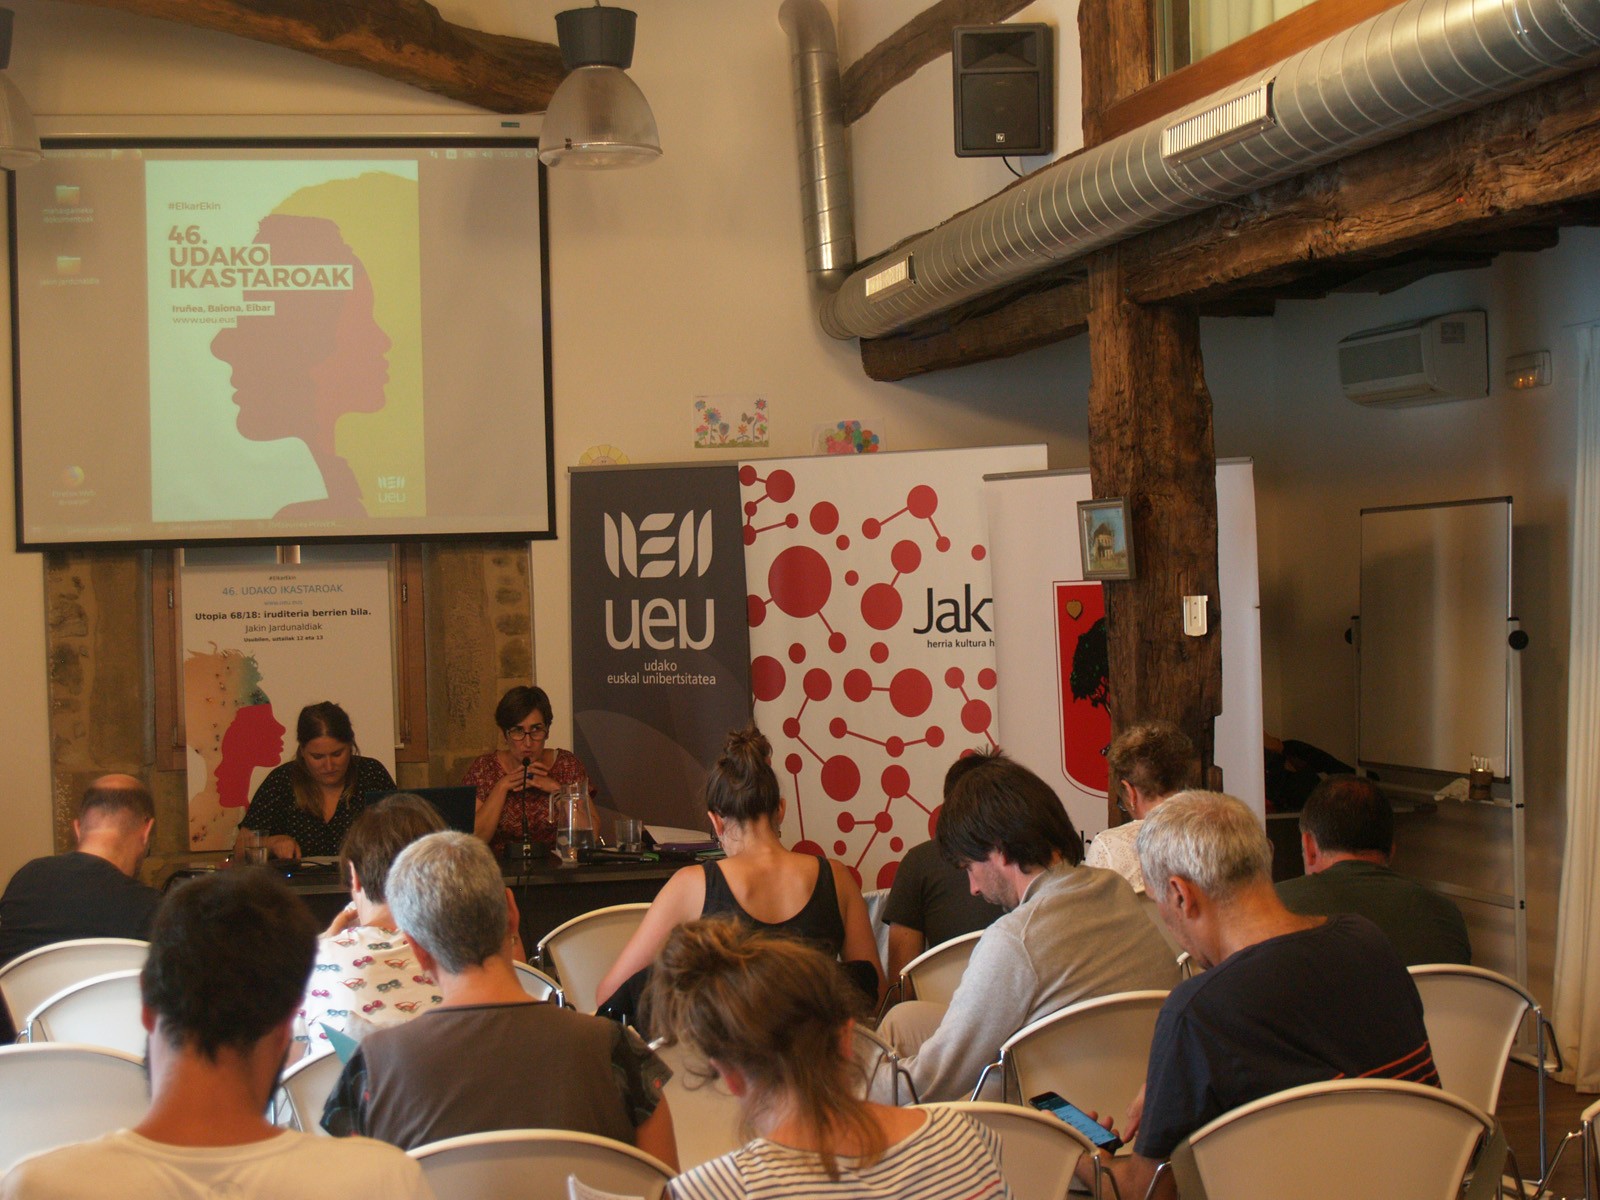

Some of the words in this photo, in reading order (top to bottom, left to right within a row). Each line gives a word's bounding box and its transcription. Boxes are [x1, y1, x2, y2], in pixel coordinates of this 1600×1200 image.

[168, 201, 221, 211] #ElkarEkin
[168, 225, 208, 245] 46.
[170, 246, 270, 267] UDAKO
[171, 267, 351, 288] IKASTAROAK
[172, 304, 206, 313] Iruñea,
[208, 304, 244, 313] Baiona,
[246, 303, 272, 312] Eibar
[173, 316, 236, 324] www.ueu.eus
[222, 586, 238, 596] 46.
[241, 585, 278, 596] UDAKO
[280, 584, 344, 594] IKASTAROAK
[195, 612, 227, 621] Utopia
[230, 611, 261, 620] 68/18:
[264, 609, 309, 618] iruditeria
[312, 608, 348, 617] berrien
[350, 607, 372, 616] bila.
[245, 624, 266, 634] Jakin
[268, 622, 323, 633] Jardunaldiak
[927, 639, 953, 648] herria
[955, 639, 987, 648] kultura
[644, 659, 678, 671] udako
[607, 672, 640, 684] euskal
[642, 672, 716, 685] unibertsitatea
